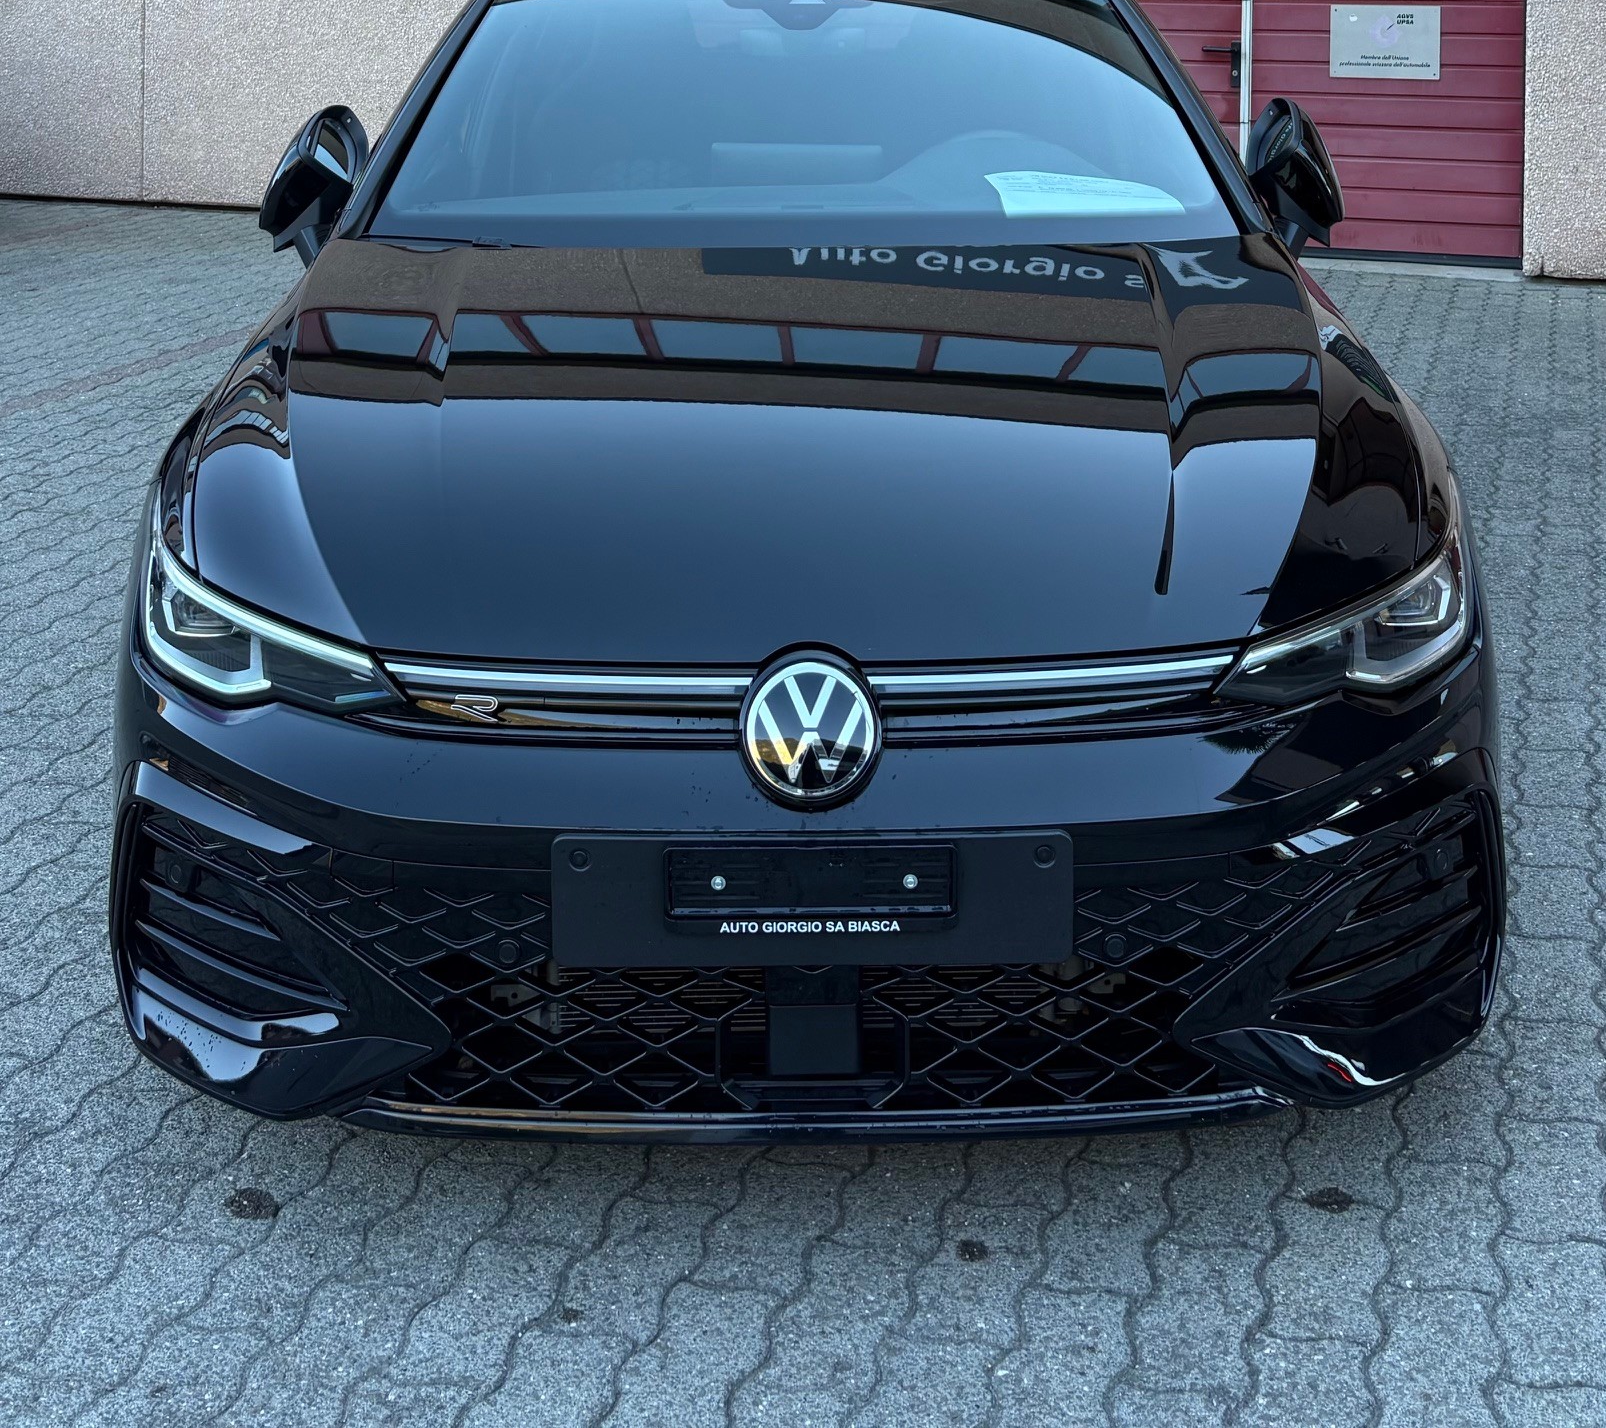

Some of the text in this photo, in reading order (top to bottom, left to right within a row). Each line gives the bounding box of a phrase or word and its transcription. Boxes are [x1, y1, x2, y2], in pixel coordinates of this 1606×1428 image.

[720, 921, 900, 933] AUTO GIORGIO SA BIASCA
